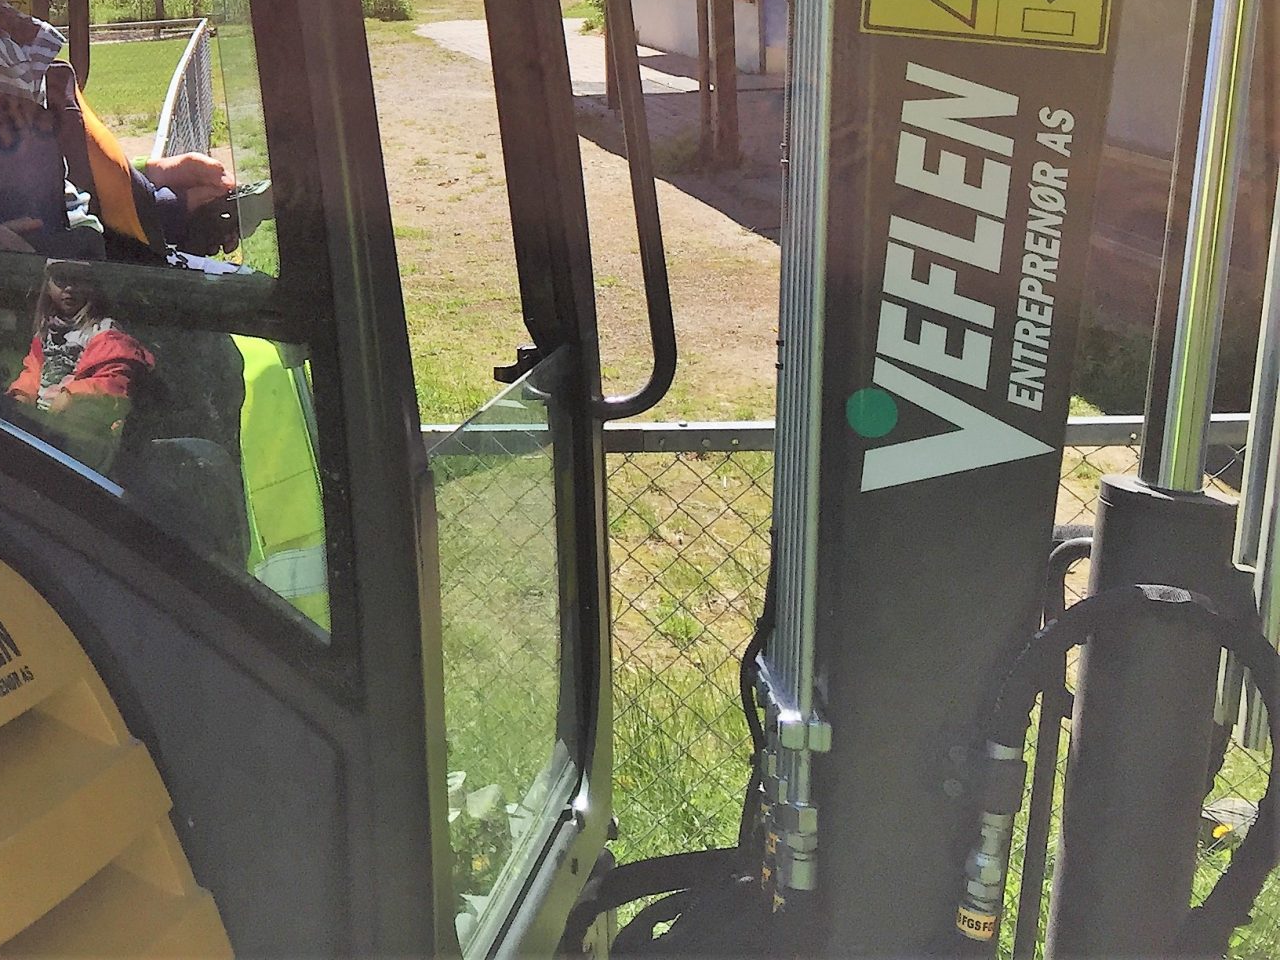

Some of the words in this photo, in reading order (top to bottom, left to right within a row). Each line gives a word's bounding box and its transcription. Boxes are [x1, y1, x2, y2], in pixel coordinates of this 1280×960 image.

[1036, 106, 1075, 158] AS
[860, 61, 1057, 493] VEFLEN
[1007, 160, 1070, 412] ENTREPRENØR
